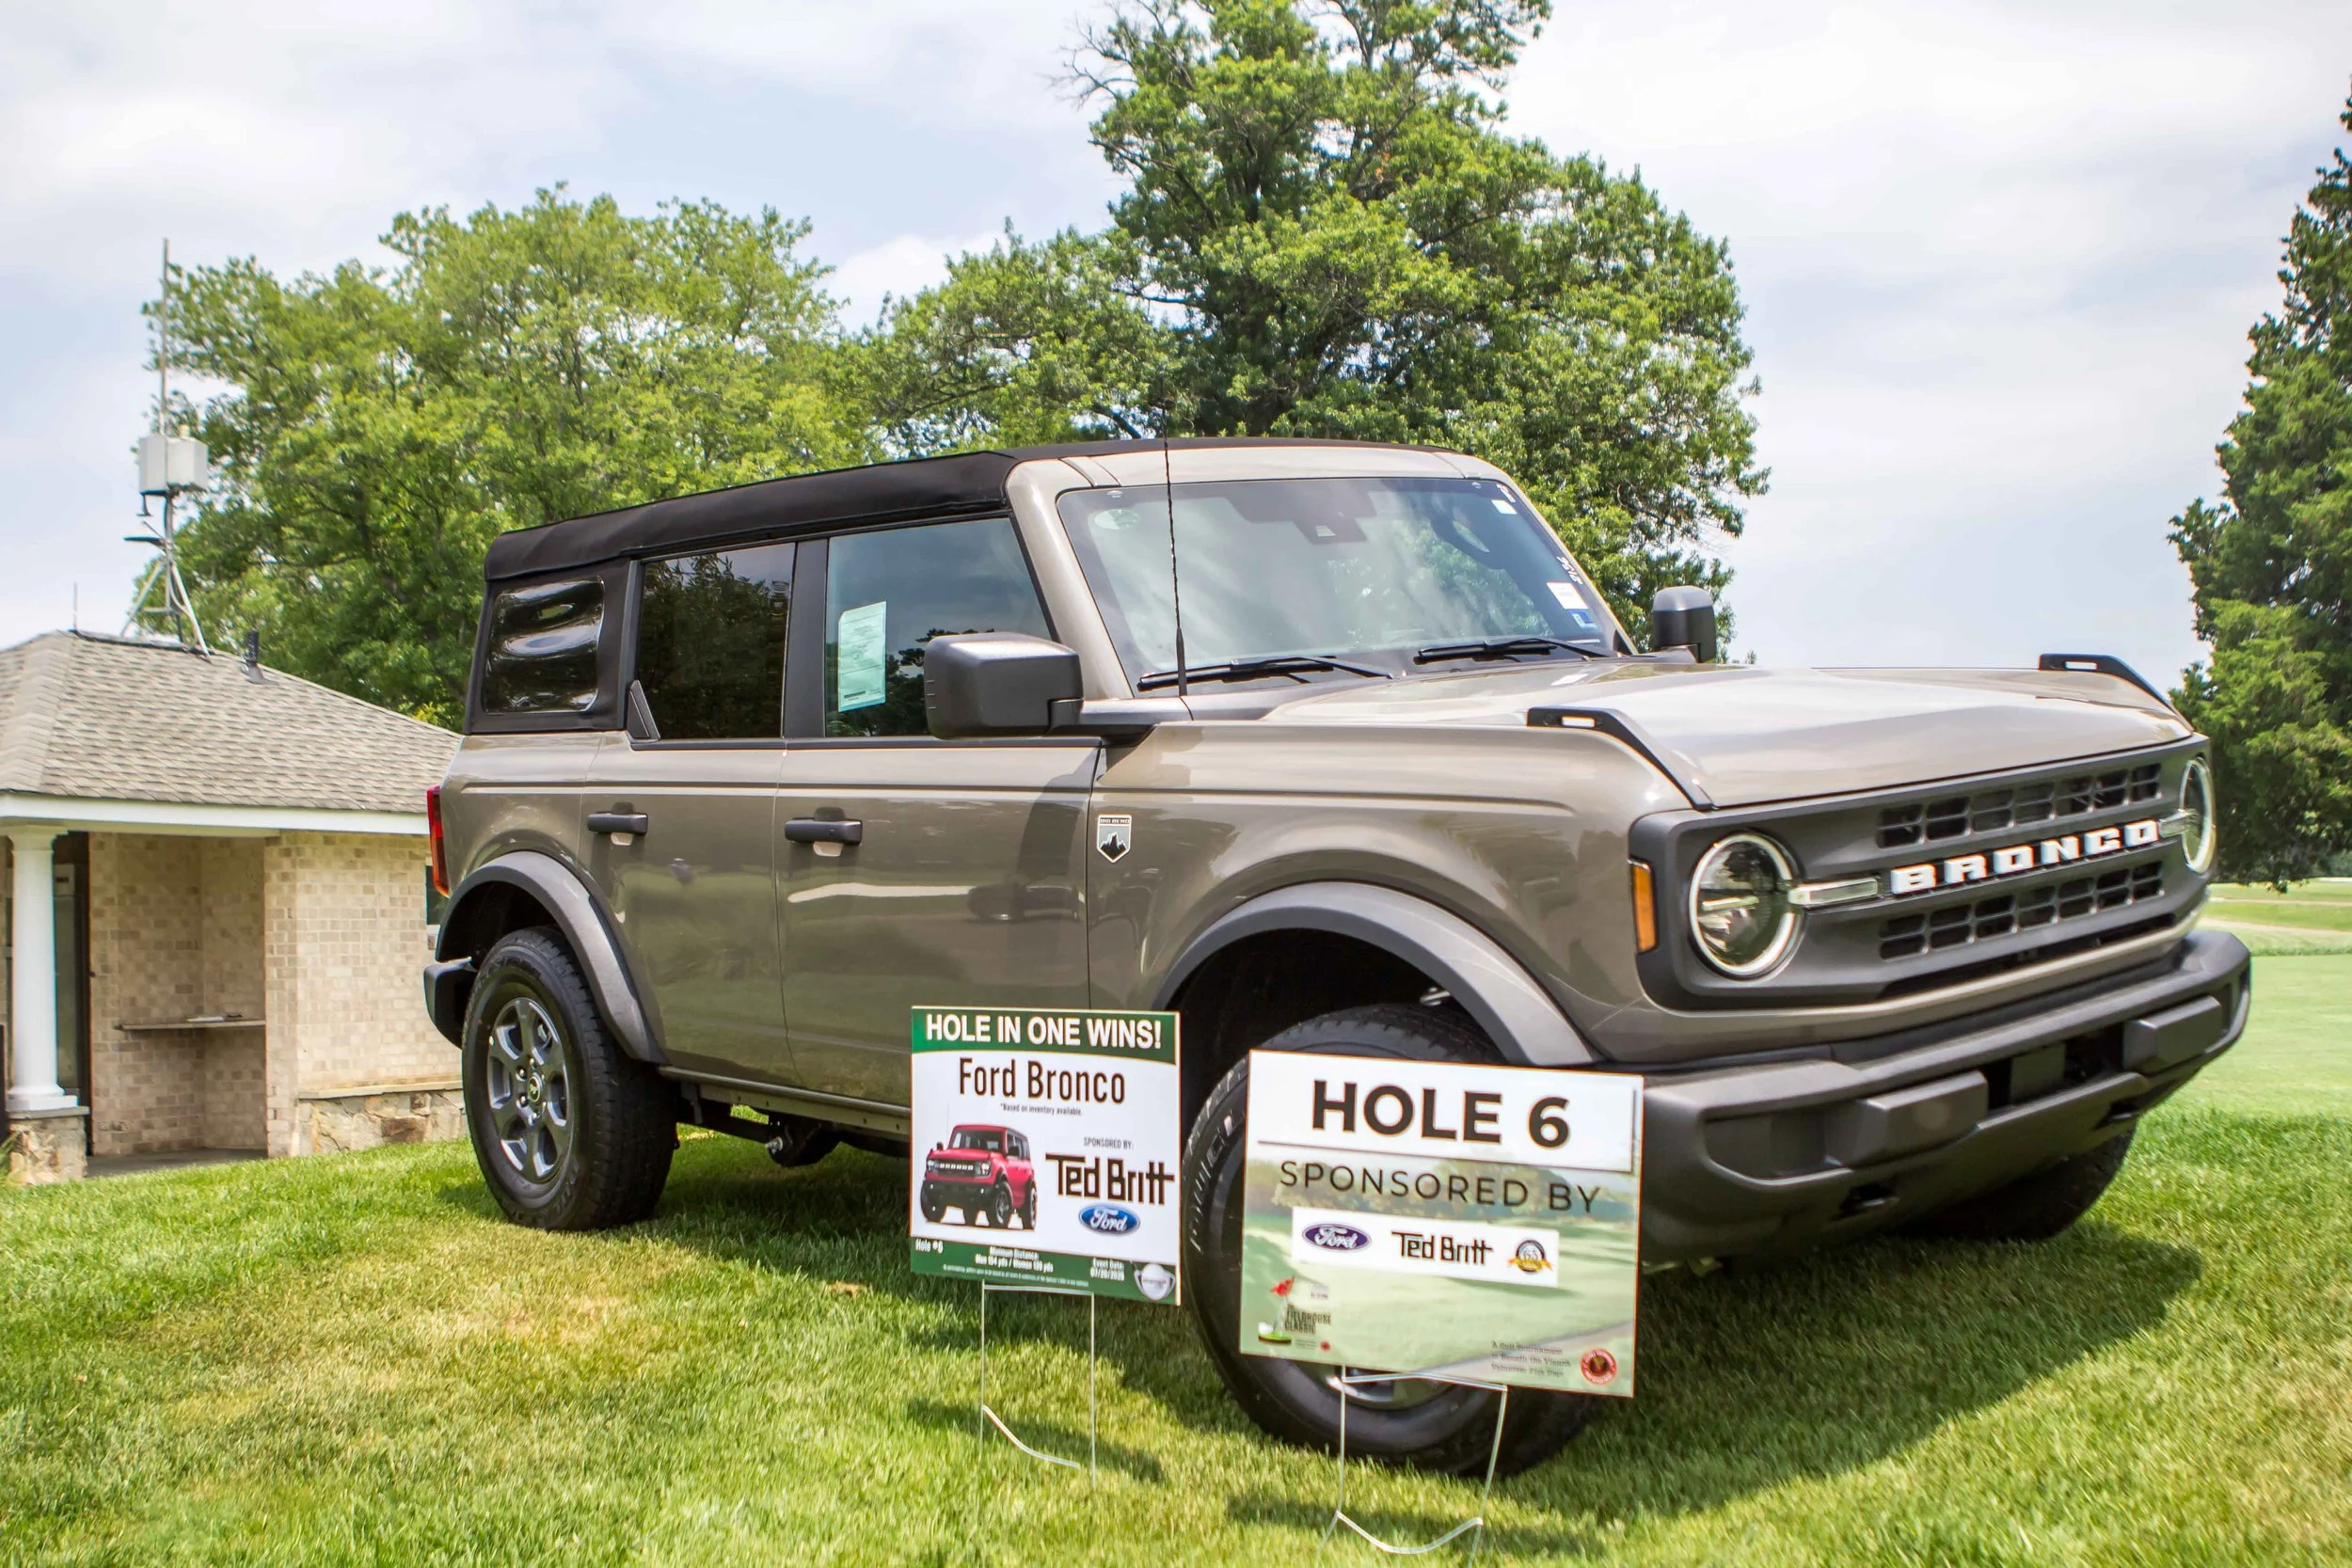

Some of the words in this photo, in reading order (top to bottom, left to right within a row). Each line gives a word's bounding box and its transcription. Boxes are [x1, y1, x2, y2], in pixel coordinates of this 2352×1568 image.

[1890, 819, 2159, 895] BRONCO
[926, 1013, 991, 1043] HOLE
[997, 1016, 1021, 1044] IN
[1027, 1017, 1081, 1046] ONE
[1087, 1018, 1162, 1049] WINS!
[960, 1056, 1016, 1098] Ford
[1027, 1060, 1125, 1104] Bronco
[1028, 1105, 1056, 1116] inventory
[1312, 1079, 1502, 1145] HOLE
[1528, 1096, 1571, 1149] 6
[1084, 1136, 1121, 1149] SPONSORED
[1045, 1152, 1101, 1199] Ted
[1107, 1158, 1175, 1206] Britt
[1279, 1161, 1529, 1207] SPONSORED
[1549, 1183, 1601, 1213] BY
[1089, 1208, 1128, 1234] Ford
[1314, 1226, 1360, 1251] Ford
[1391, 1230, 1435, 1259] Ted
[1440, 1236, 1494, 1266] Britt
